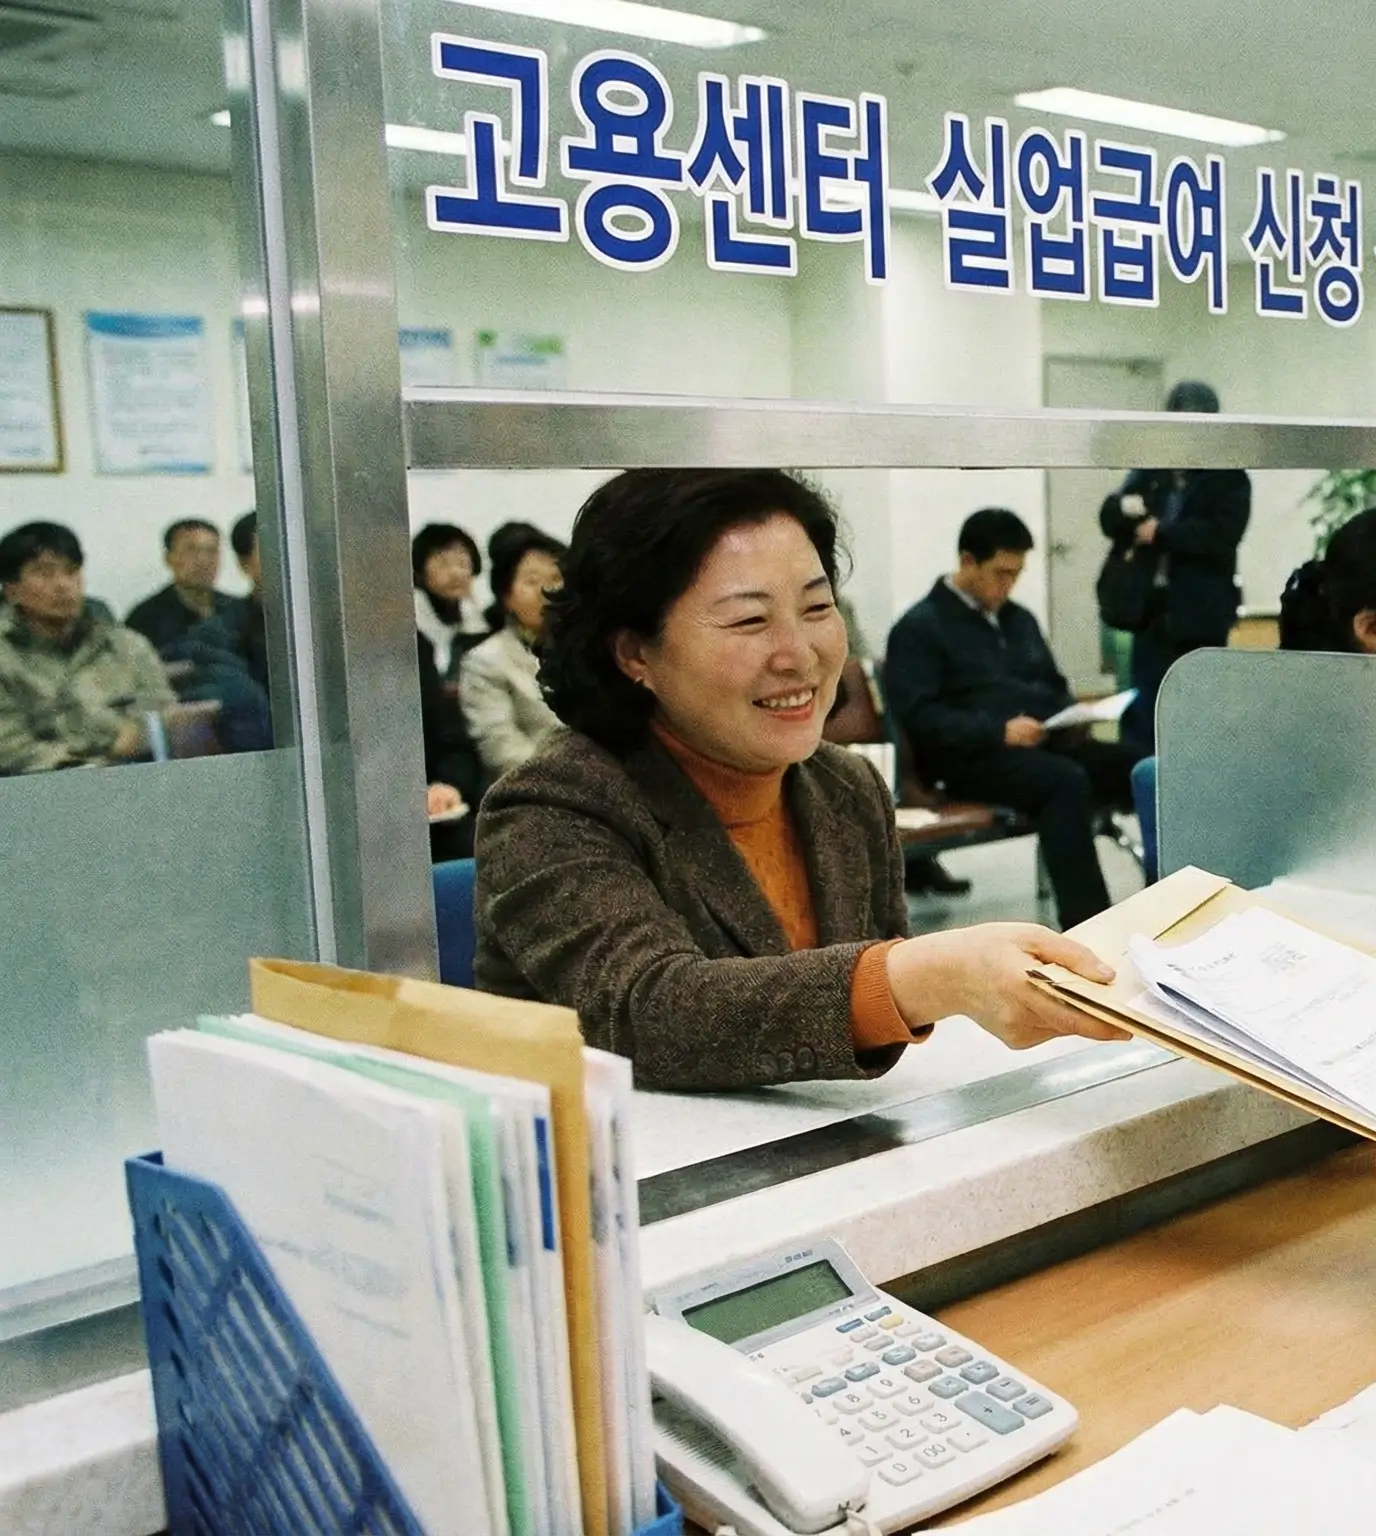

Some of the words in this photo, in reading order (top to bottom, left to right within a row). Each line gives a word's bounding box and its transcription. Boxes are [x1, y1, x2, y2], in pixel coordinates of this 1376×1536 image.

[430, 38, 889, 282] 고용센터
[928, 115, 1227, 312] 실업급여
[1246, 169, 1362, 326] 신청
[908, 1396, 921, 1405] 6
[899, 1428, 916, 1438] 2
[933, 1412, 948, 1423] 3
[892, 1463, 908, 1472] 0
[922, 1443, 947, 1457] 00
